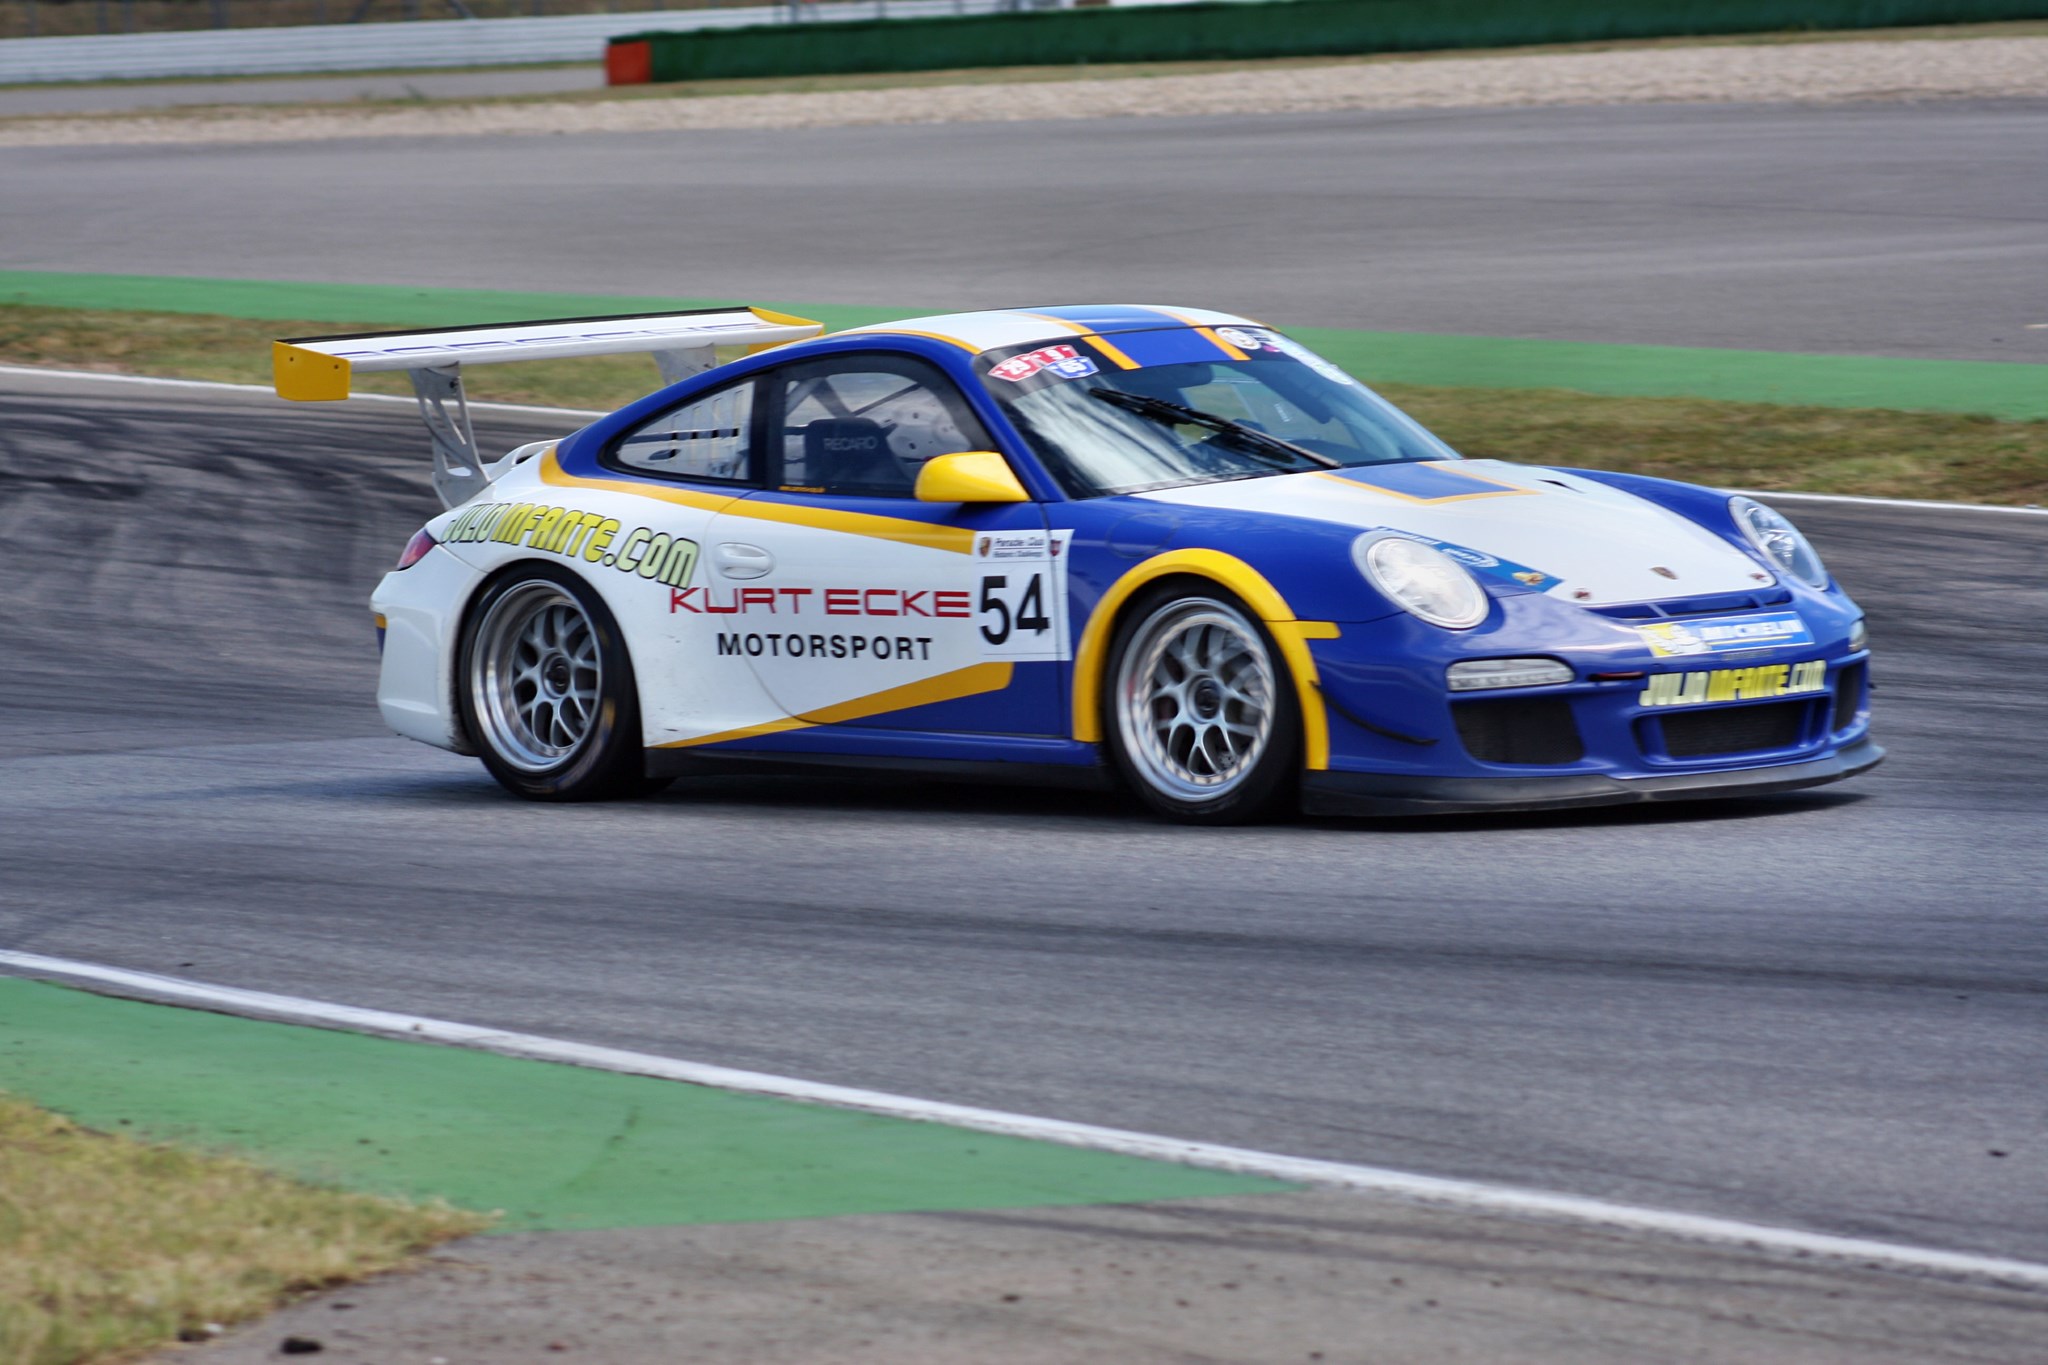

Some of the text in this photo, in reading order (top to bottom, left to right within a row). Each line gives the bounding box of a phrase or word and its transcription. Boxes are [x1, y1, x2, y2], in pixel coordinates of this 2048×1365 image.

[823, 435, 879, 451] RECARO
[670, 587, 972, 618] KURT ECKE
[980, 573, 1050, 646] 54
[717, 632, 932, 660] MOTORSPORT
